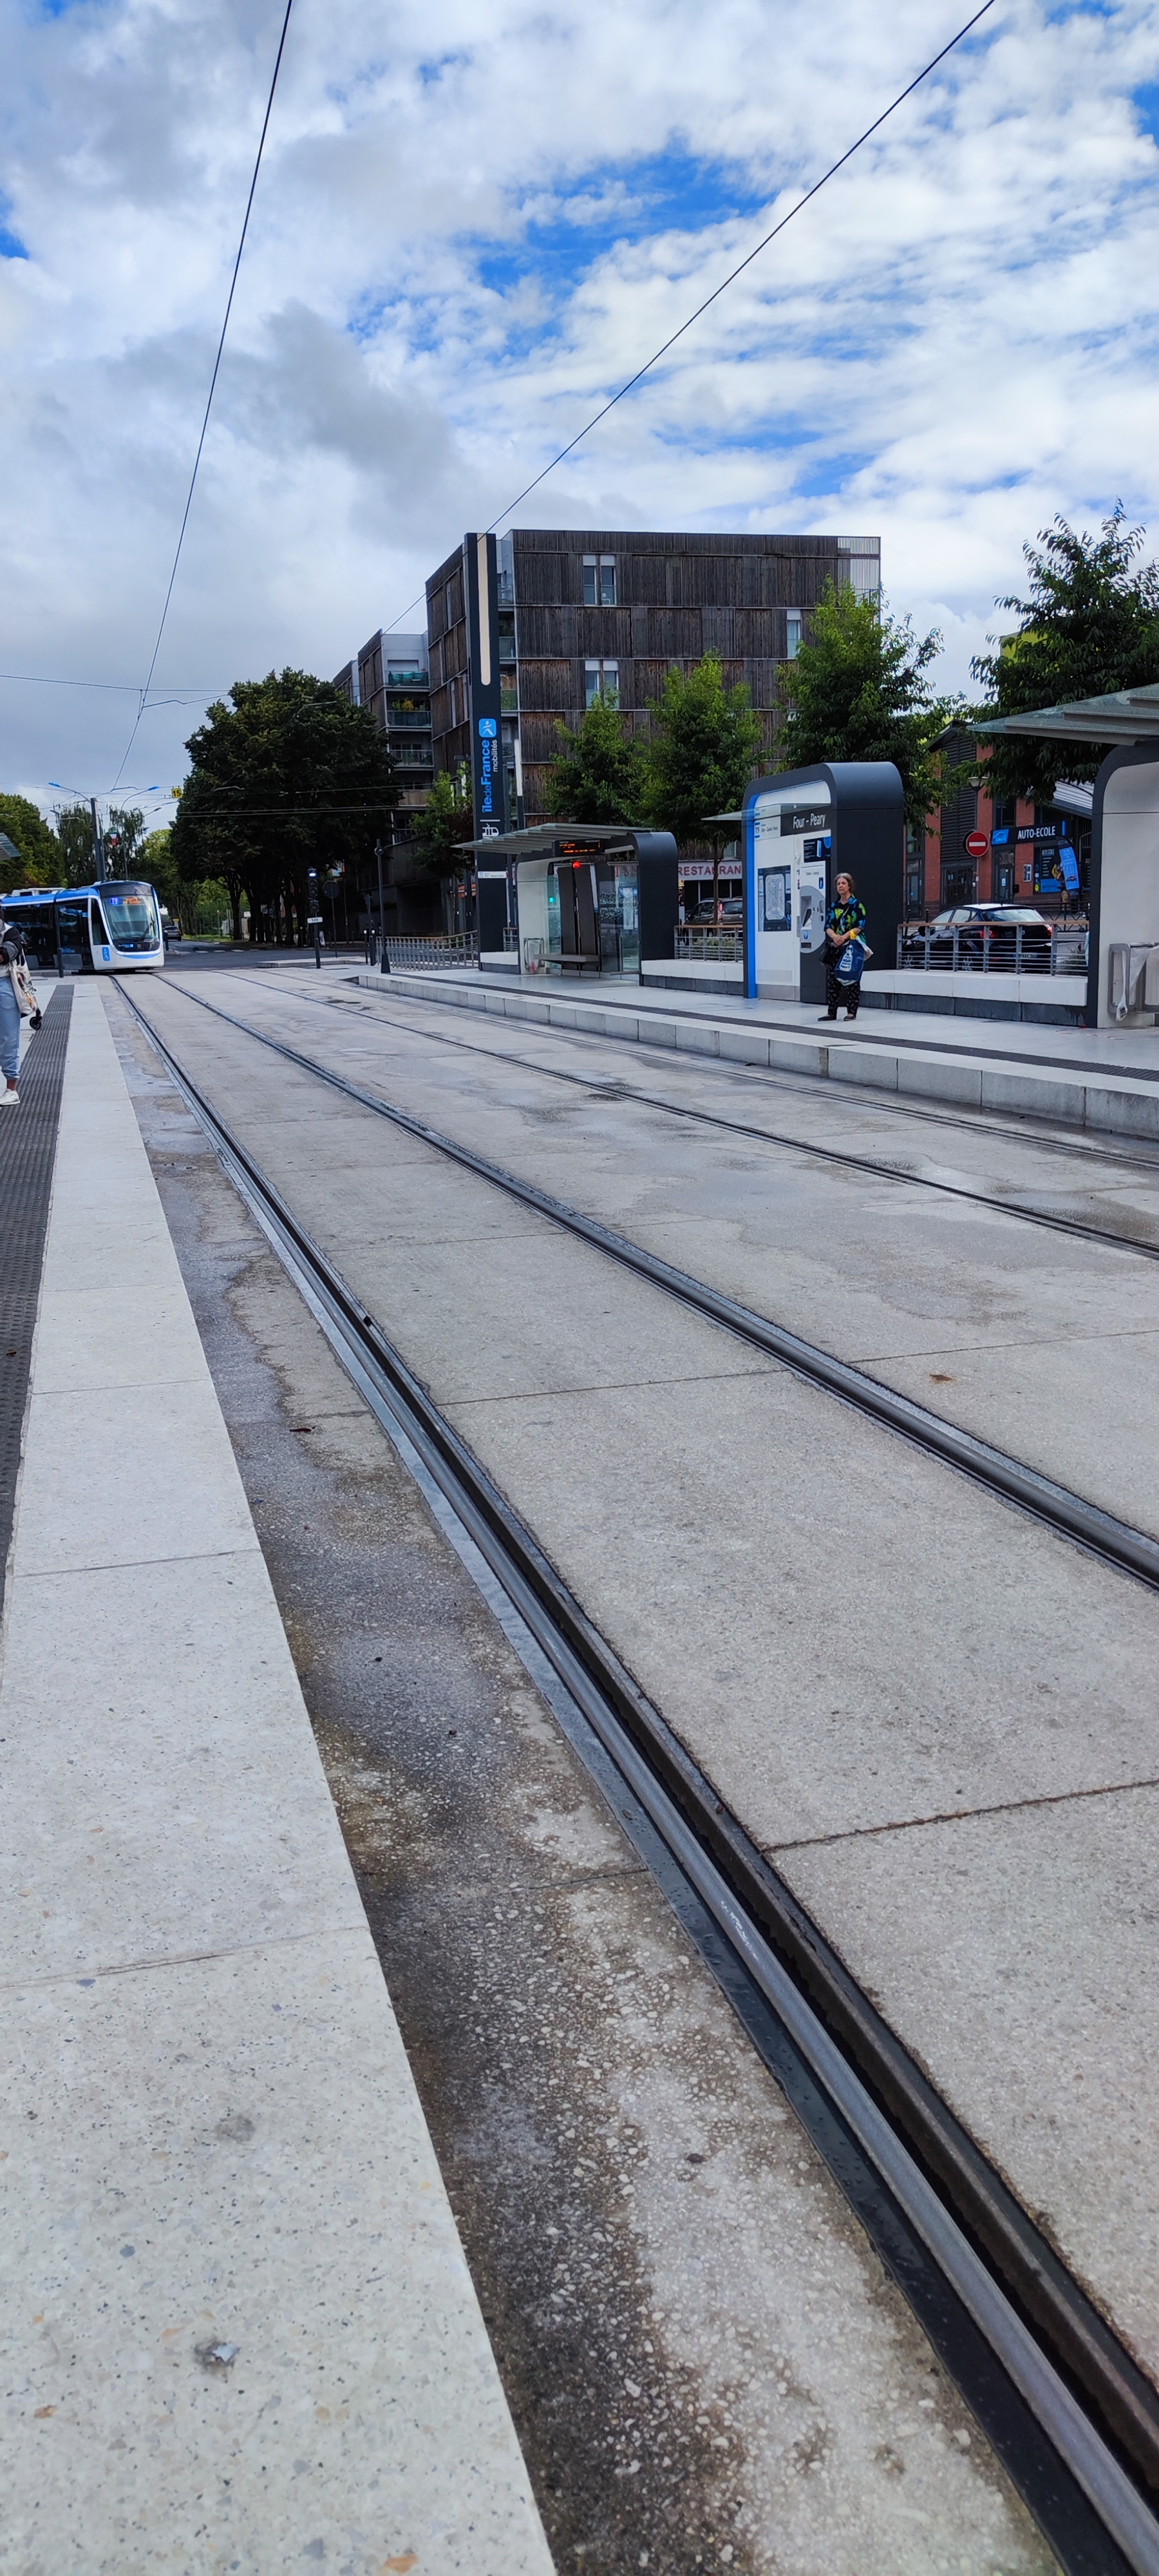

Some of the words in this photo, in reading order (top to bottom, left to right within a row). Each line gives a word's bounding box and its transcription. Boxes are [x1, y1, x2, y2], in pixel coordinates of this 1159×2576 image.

[793, 816, 805, 829] Four
[810, 813, 826, 828] Peary
[1017, 826, 1056, 840] AUTO-ECOLE
